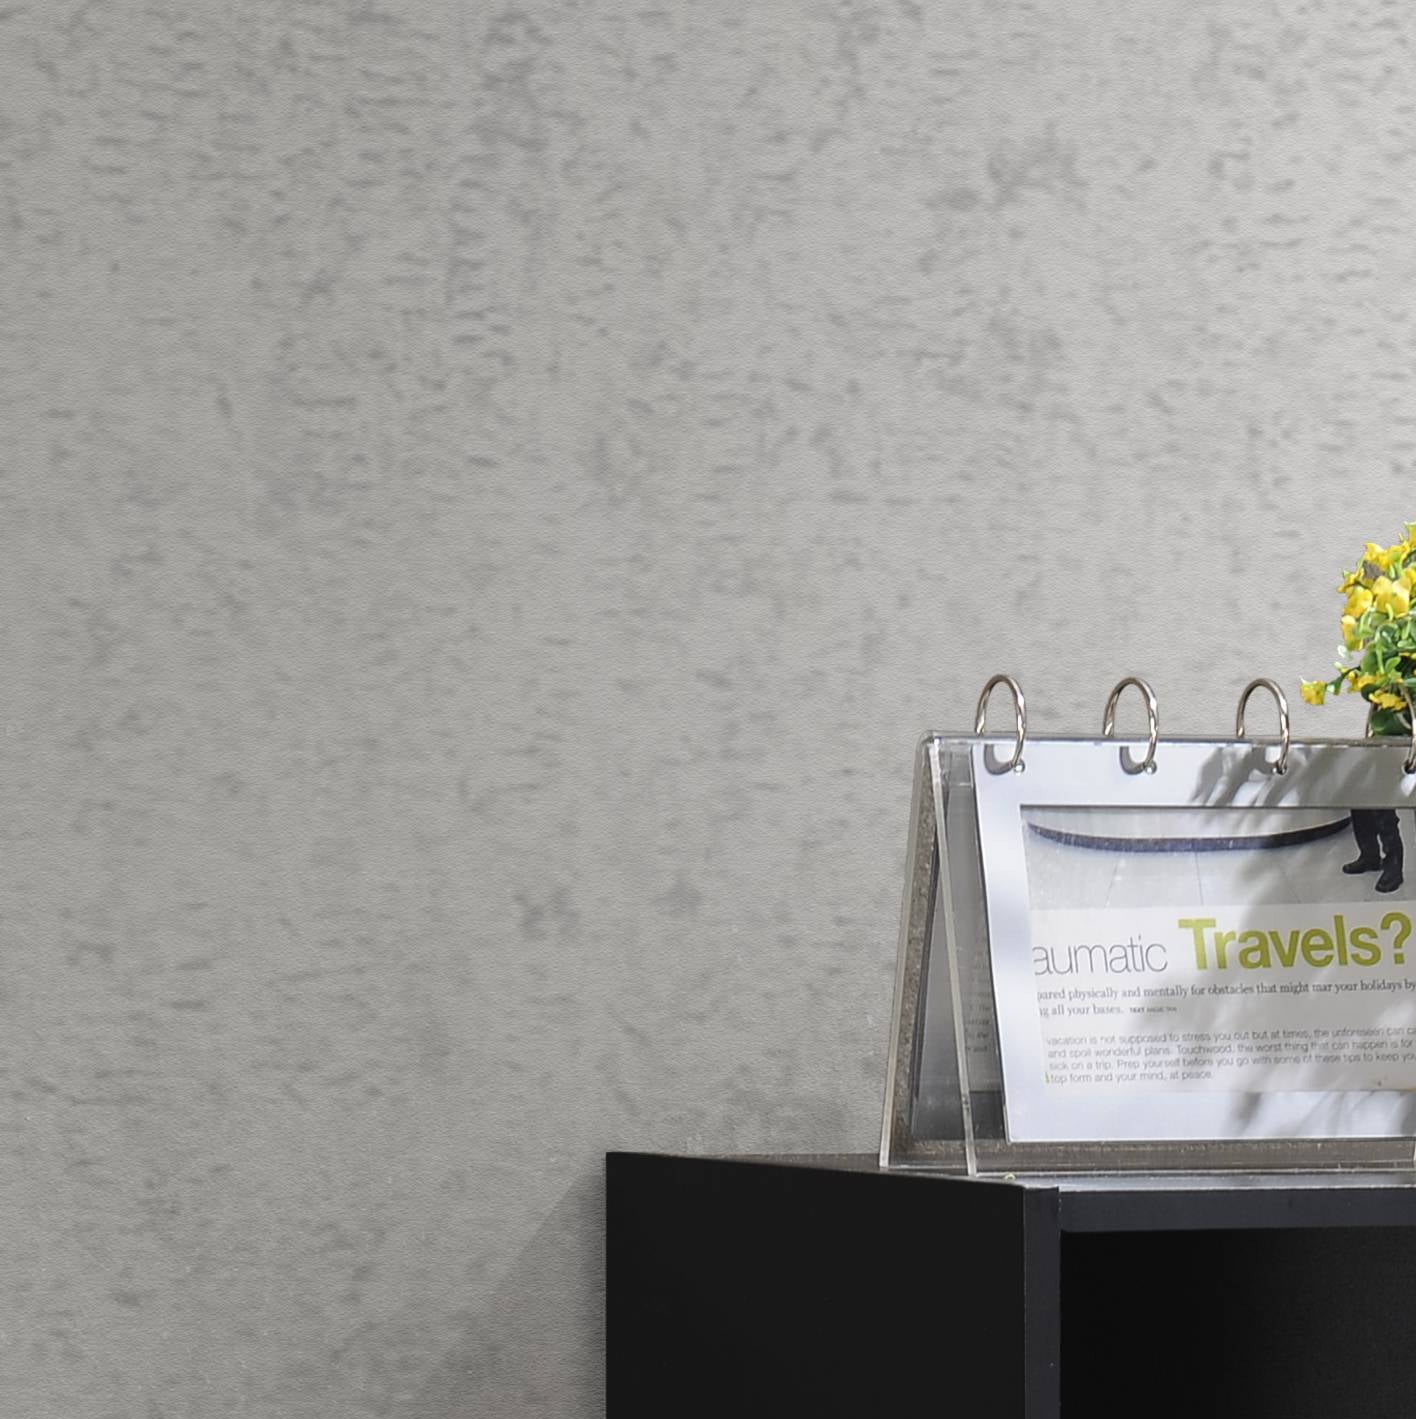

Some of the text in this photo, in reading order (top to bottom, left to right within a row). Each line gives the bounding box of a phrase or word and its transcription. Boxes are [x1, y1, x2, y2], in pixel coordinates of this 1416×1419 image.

[1033, 912, 1413, 976] aumatic Travels?
[1068, 986, 1118, 1001] physically
[1122, 986, 1140, 998] and
[1143, 984, 1188, 999] mentally
[1191, 984, 1205, 995] for
[1208, 983, 1254, 995] obstacles
[1256, 982, 1277, 994] that
[1280, 981, 1309, 996] might
[1312, 983, 1332, 993] mar
[1332, 982, 1358, 994] your
[1360, 979, 1402, 993] holidays
[1404, 978, 1416, 992] by
[1051, 1004, 1064, 1015] all
[1067, 1006, 1089, 1018] your
[1093, 1004, 1124, 1015] bases.
[1119, 1033, 1167, 1044] supposed
[1182, 1032, 1211, 1041] stress
[1213, 1033, 1232, 1043] you
[1233, 1032, 1250, 1041] out
[1251, 1031, 1268, 1040] but
[1094, 1046, 1141, 1057] wonderful
[1255, 1043, 1281, 1053] worst
[1095, 1072, 1113, 1081] and
[1115, 1072, 1137, 1083] your
